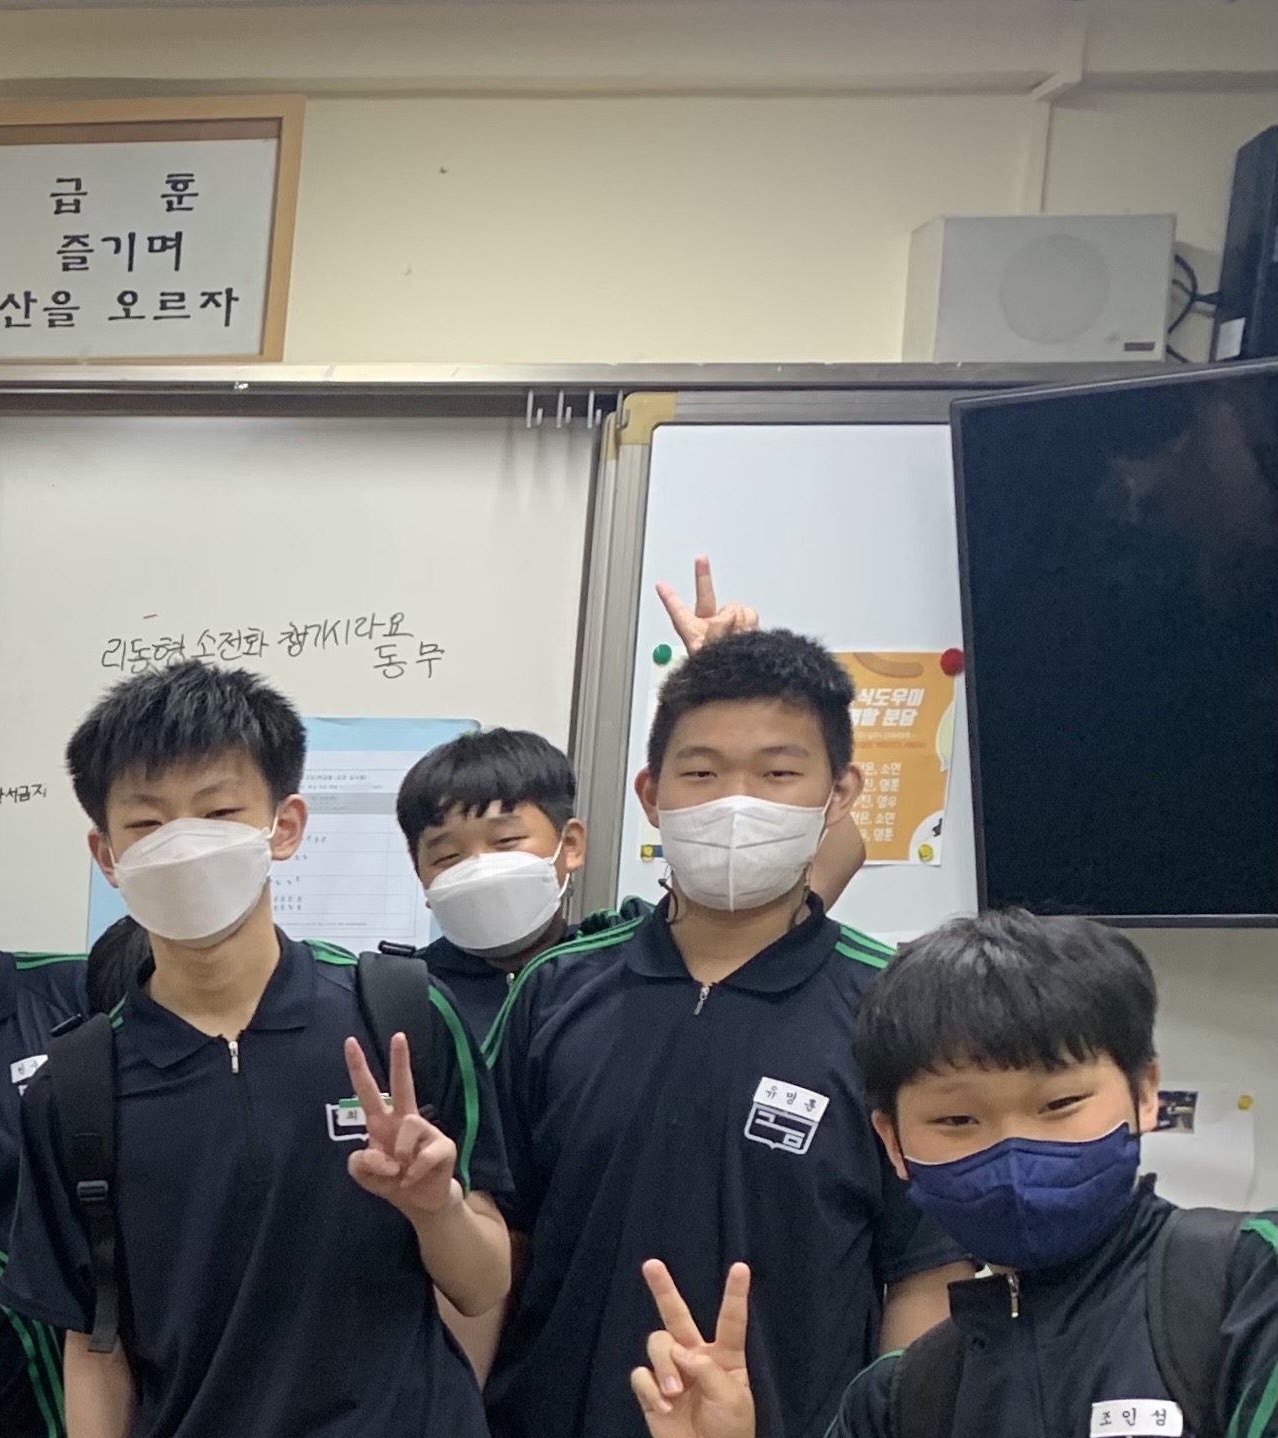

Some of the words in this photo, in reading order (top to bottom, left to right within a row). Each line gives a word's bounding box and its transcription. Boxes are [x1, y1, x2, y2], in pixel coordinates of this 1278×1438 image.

[55, 231, 184, 273] 즐기며
[107, 286, 240, 328] 오르자
[1098, 1407, 1168, 1427] 조인성
